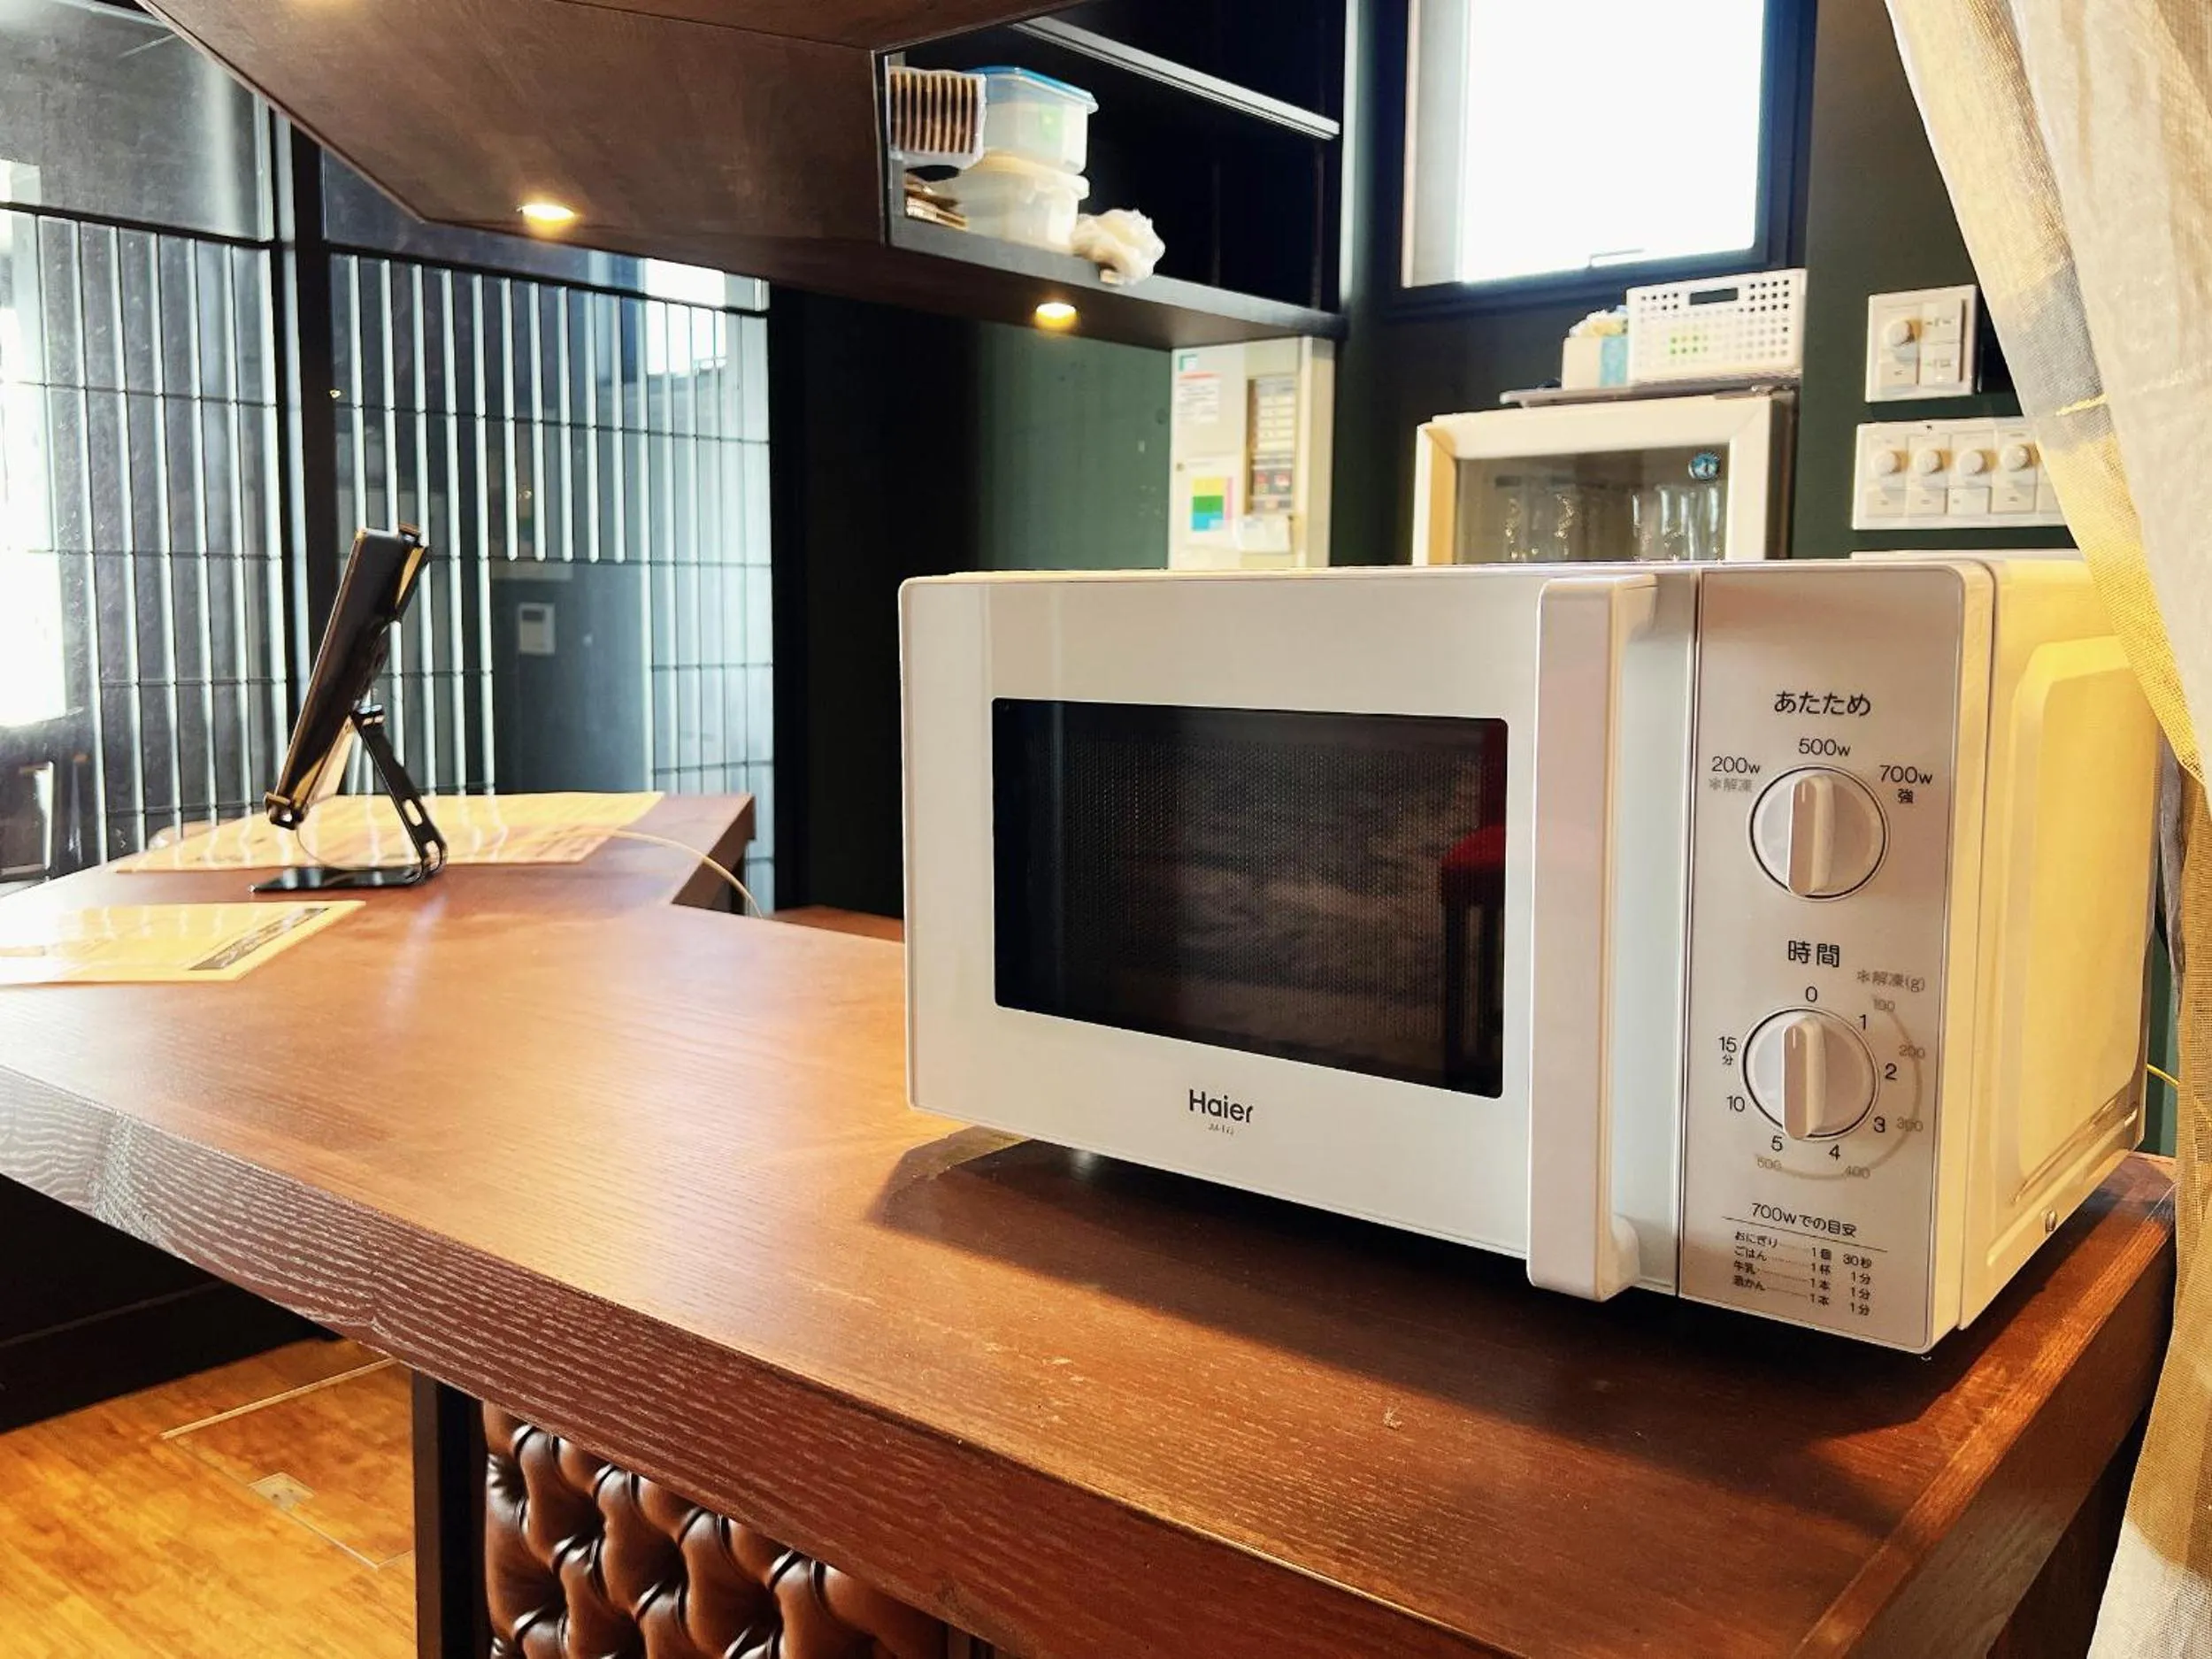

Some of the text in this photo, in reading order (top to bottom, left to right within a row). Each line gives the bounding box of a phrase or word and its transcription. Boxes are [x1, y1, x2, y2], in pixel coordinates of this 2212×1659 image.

[1774, 691, 1871, 717] あたため
[1897, 788, 1914, 804] 強
[1787, 941, 1840, 968] 時間
[1805, 986, 1818, 1002] 0
[1859, 1014, 1867, 1030] 1
[1718, 1036, 1737, 1053] 15
[1899, 1044, 1925, 1059] 200
[1722, 1054, 1733, 1065] 分
[1885, 1063, 1897, 1080] 2
[1189, 1088, 1254, 1123] Haier
[1726, 1095, 1745, 1112] 10
[1874, 1117, 1886, 1133] 3
[1770, 1135, 1783, 1152] 5
[1829, 1144, 1840, 1161] 4
[1735, 1232, 1778, 1248] おにぎり
[1734, 1246, 1768, 1262] ごはん
